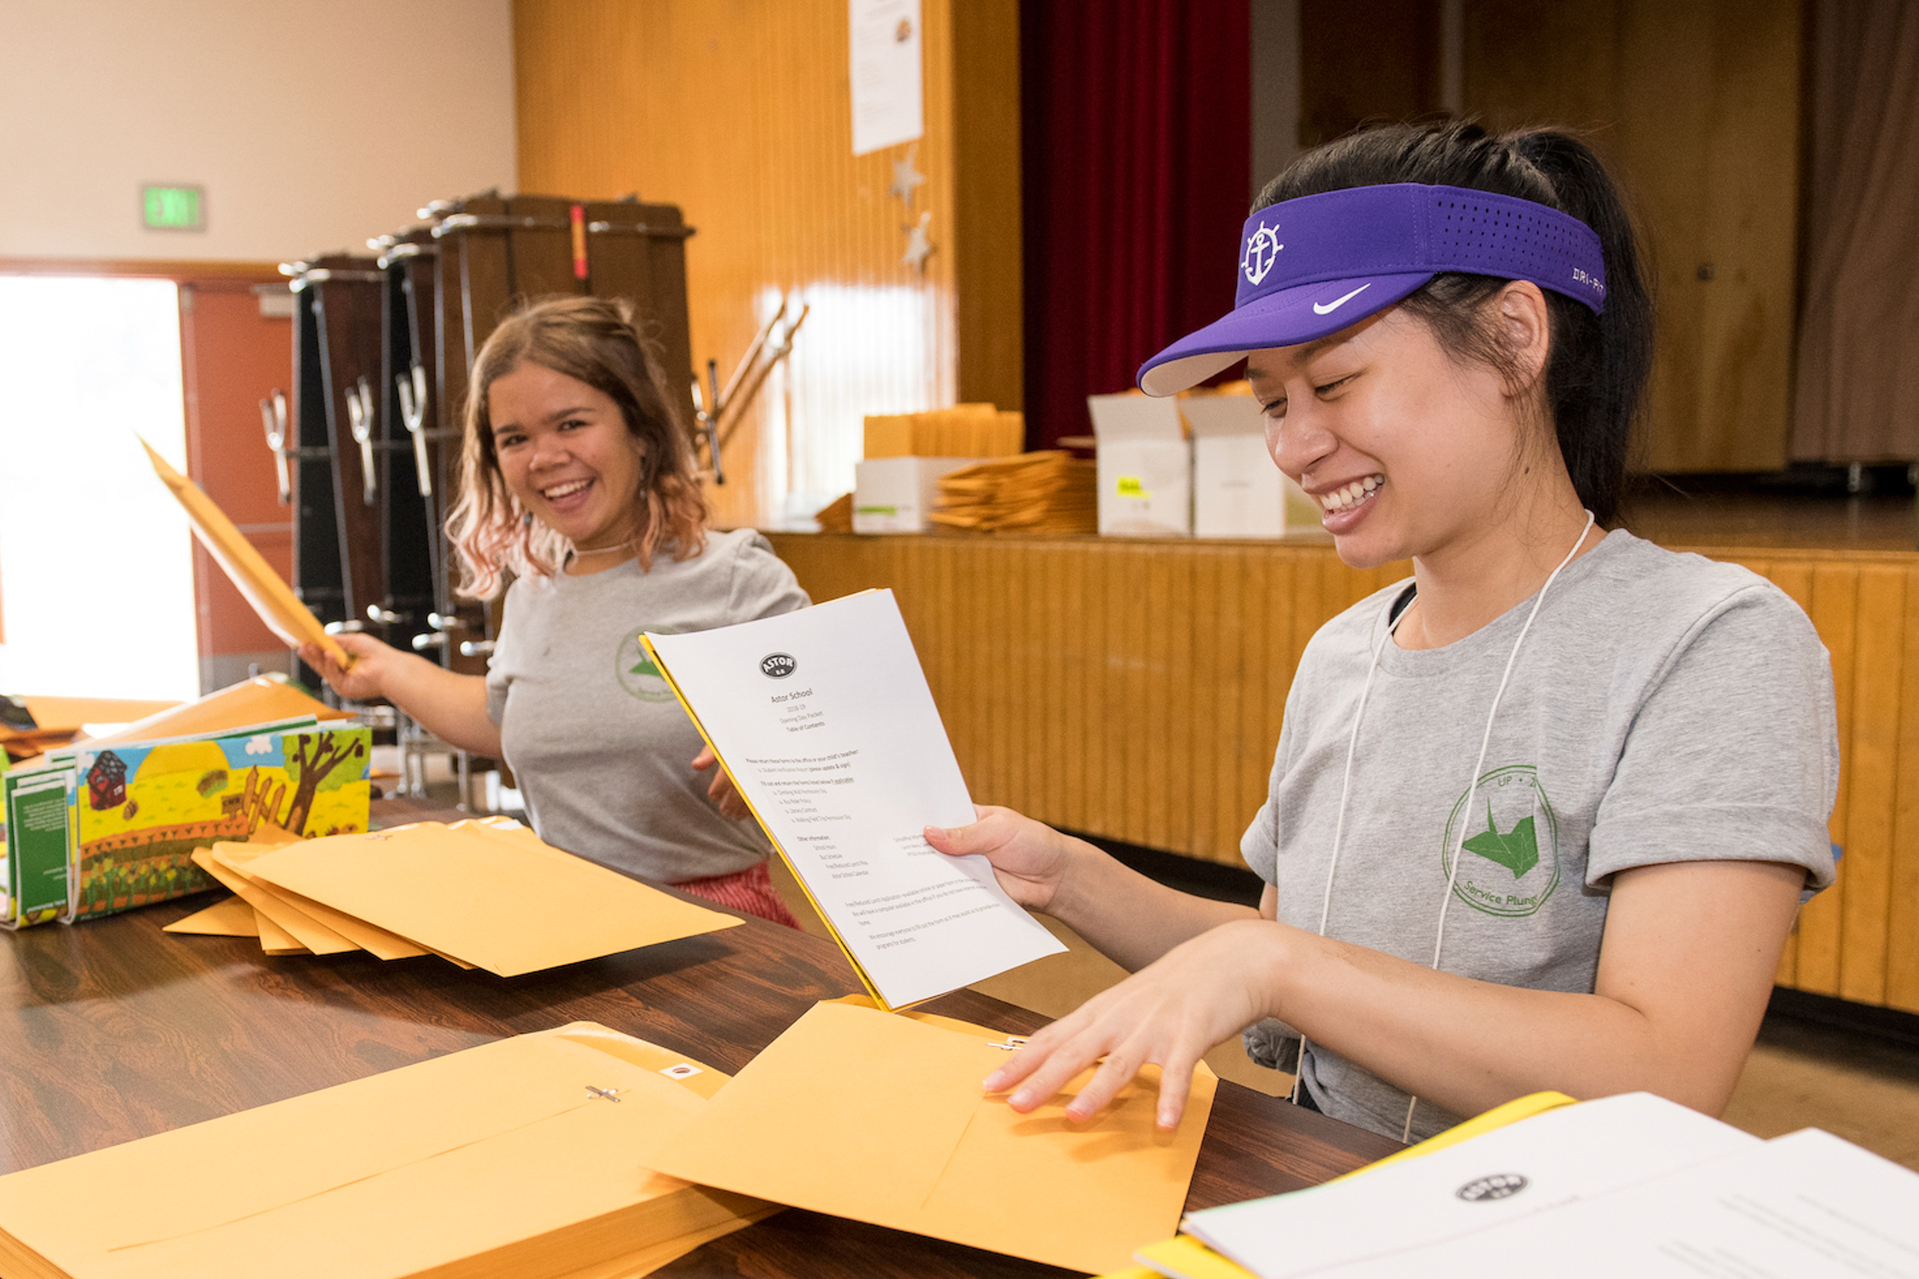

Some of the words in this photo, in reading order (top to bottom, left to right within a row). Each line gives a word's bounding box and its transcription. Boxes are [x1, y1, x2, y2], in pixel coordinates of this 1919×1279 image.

[1572, 267, 1604, 296] DRI-FIT
[762, 656, 795, 673] ASTOR
[771, 695, 789, 703] Astor
[789, 687, 814, 700] School
[804, 722, 826, 730] Contents
[1498, 775, 1513, 787] UP
[1464, 880, 1502, 904] Service
